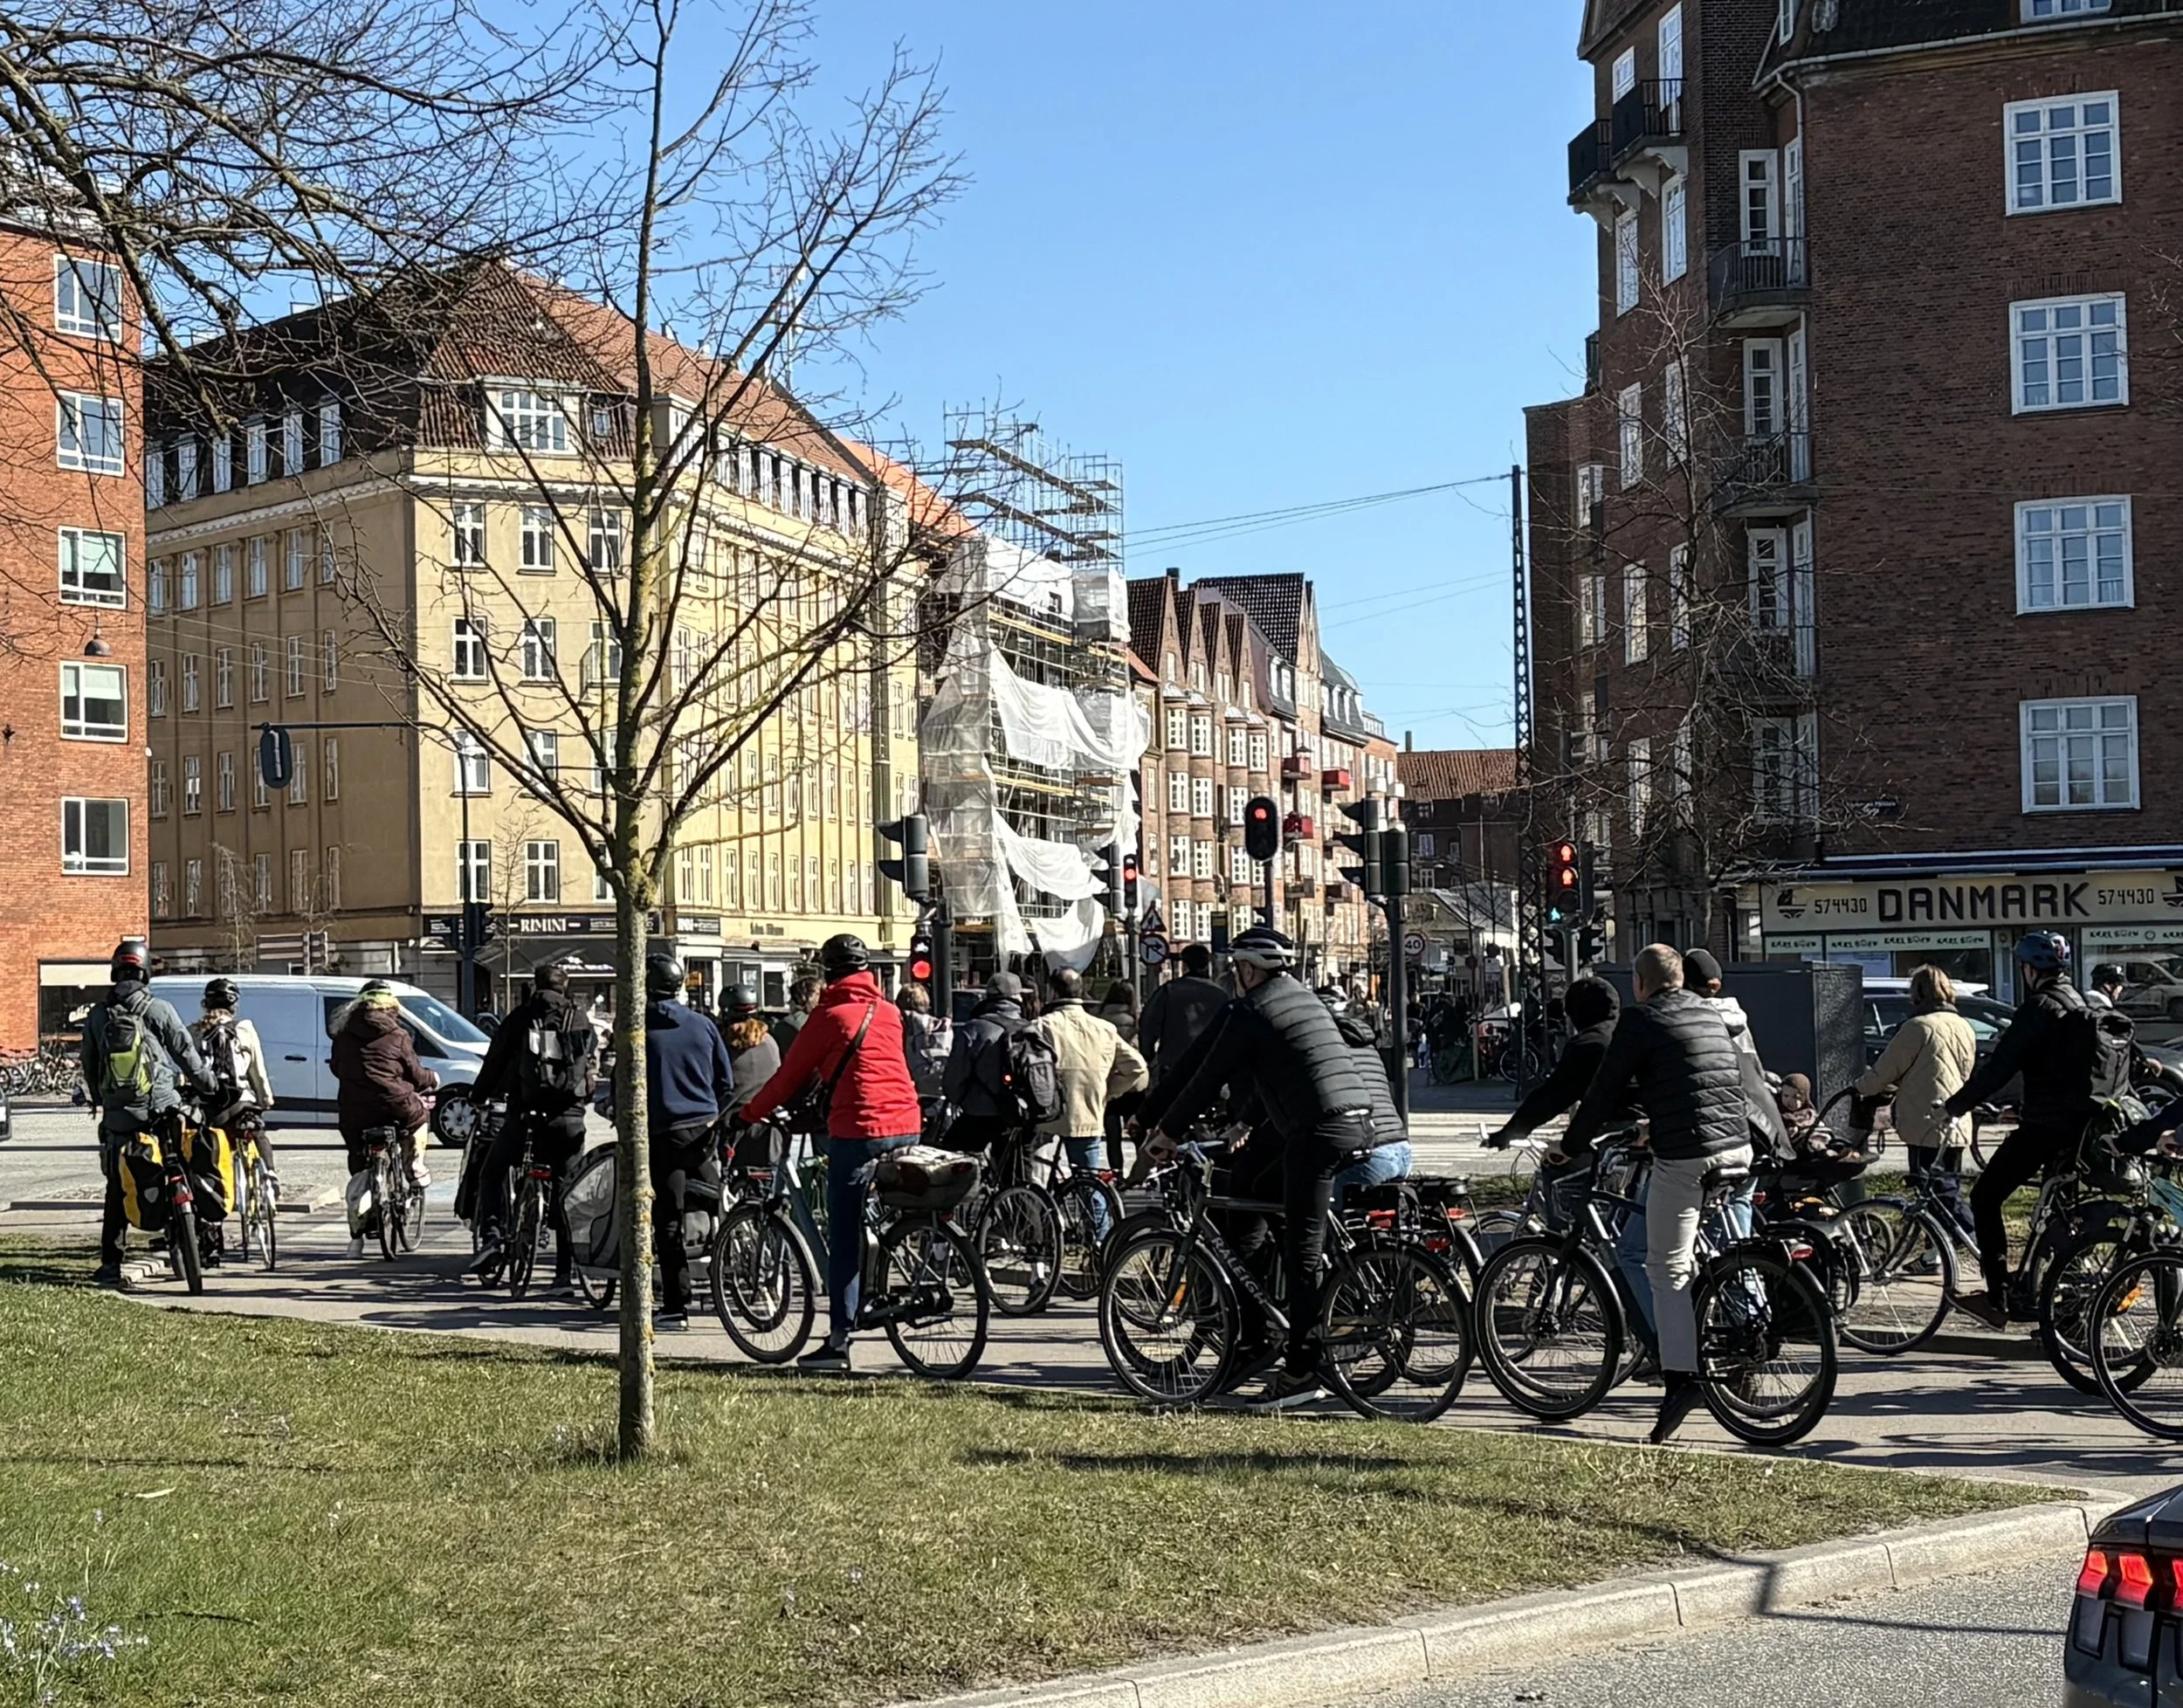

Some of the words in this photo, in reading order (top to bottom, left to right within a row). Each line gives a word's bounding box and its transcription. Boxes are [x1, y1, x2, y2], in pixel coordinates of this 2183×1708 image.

[1815, 898, 1867, 913] 574430
[1877, 882, 2090, 922] DANMARK
[2097, 888, 2154, 905] 574430
[520, 918, 566, 933] RIMINI
[1405, 940, 1422, 949] 40
[1211, 1236, 1264, 1305] RALEIGH
